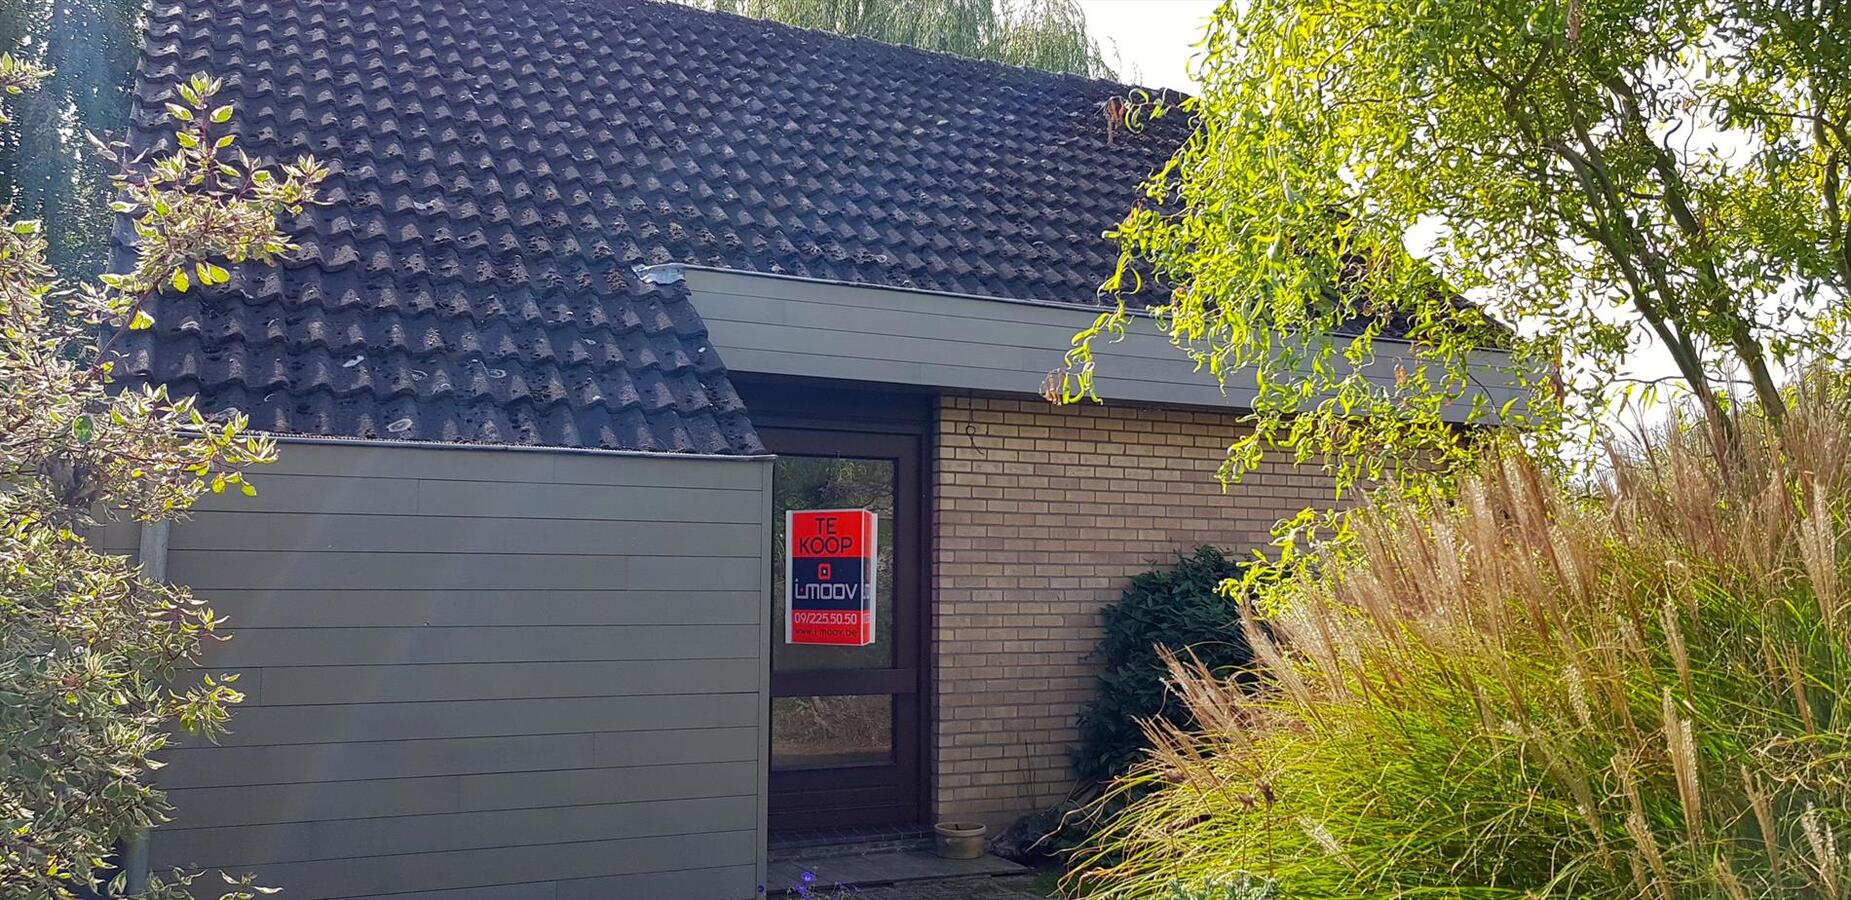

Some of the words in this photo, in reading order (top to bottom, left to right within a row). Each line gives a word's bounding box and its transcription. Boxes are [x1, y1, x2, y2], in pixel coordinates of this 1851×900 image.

[816, 517, 837, 535] TE
[799, 536, 853, 554] KOOP
[794, 612, 857, 625] 09/225.50.50
